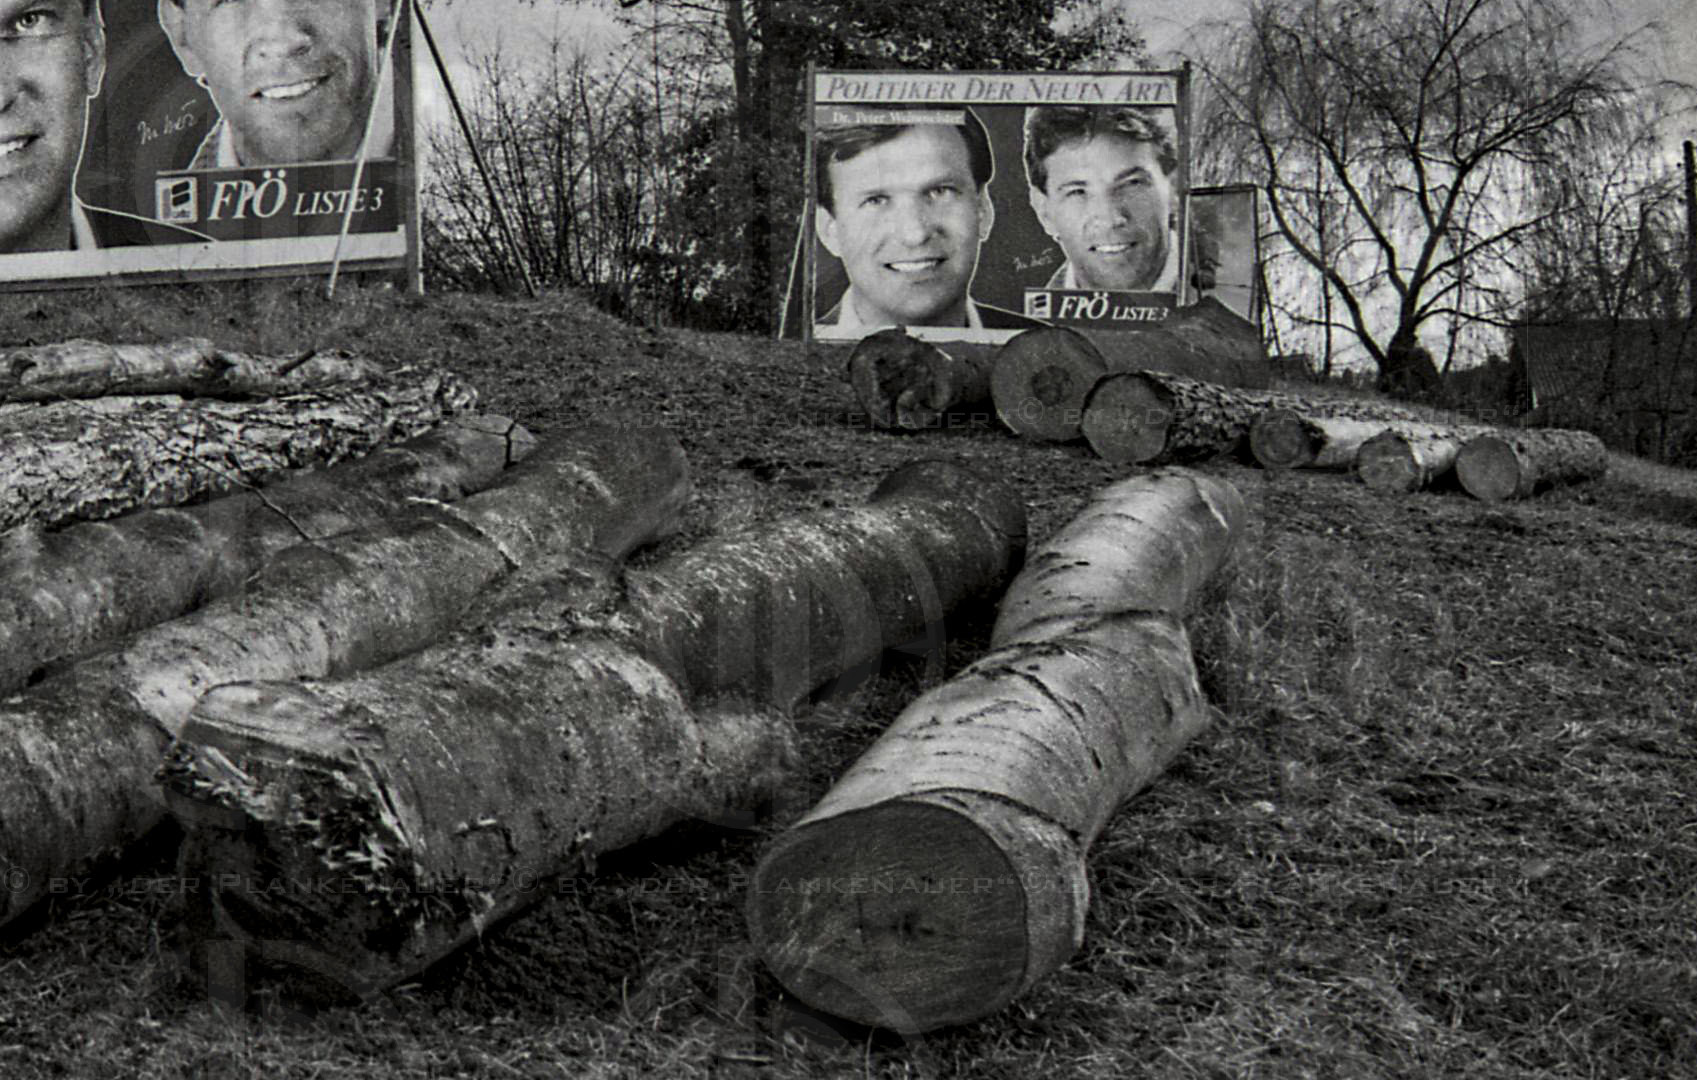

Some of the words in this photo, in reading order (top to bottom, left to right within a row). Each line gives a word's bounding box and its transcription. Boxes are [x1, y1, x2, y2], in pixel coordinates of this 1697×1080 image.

[828, 77, 957, 100] POLITIKER
[962, 77, 1014, 101] DER
[1115, 78, 1170, 102] ART
[207, 169, 288, 220] FPÖ
[293, 188, 368, 217] LISTE
[370, 187, 383, 212] 3
[1058, 291, 1110, 320] FPÖ
[1111, 305, 1159, 321] LISTE
